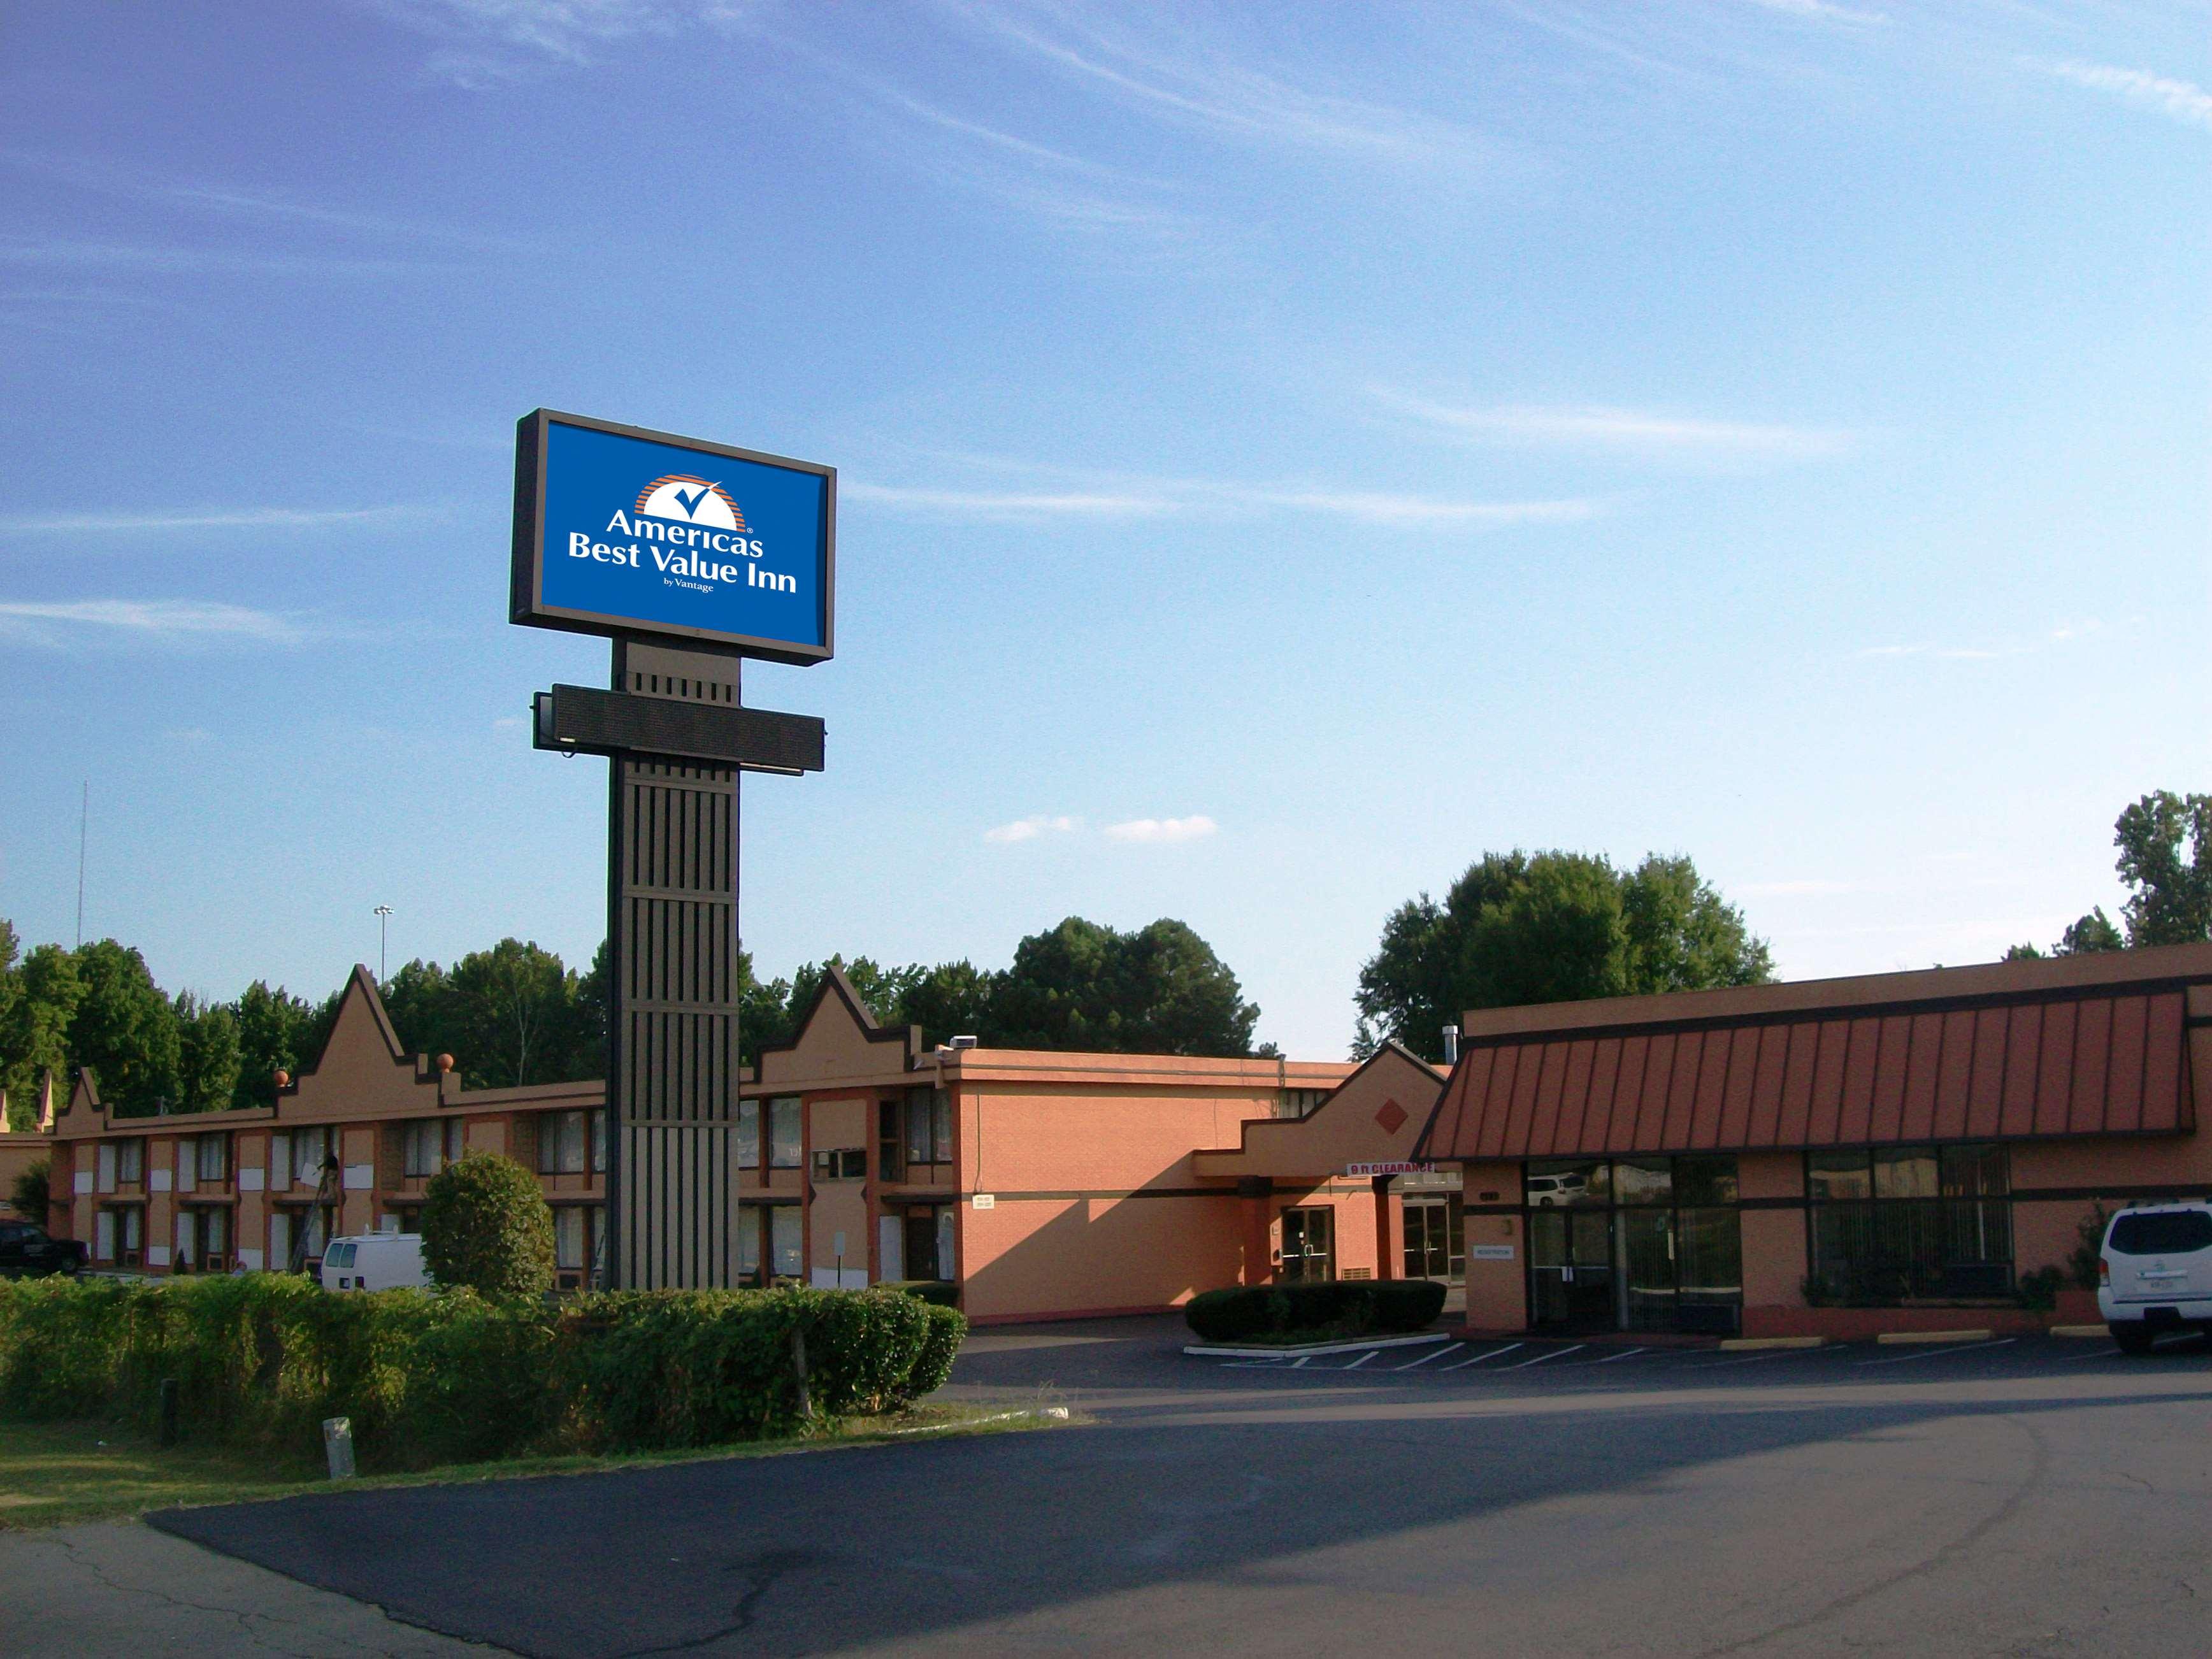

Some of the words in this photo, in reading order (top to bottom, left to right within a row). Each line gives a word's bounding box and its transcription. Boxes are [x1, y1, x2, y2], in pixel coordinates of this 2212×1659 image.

[606, 509, 764, 559] Americas
[569, 531, 641, 568] Best
[650, 545, 738, 584] Value
[748, 563, 797, 594] Inn
[663, 577, 673, 587] by
[675, 578, 714, 593] Vantage
